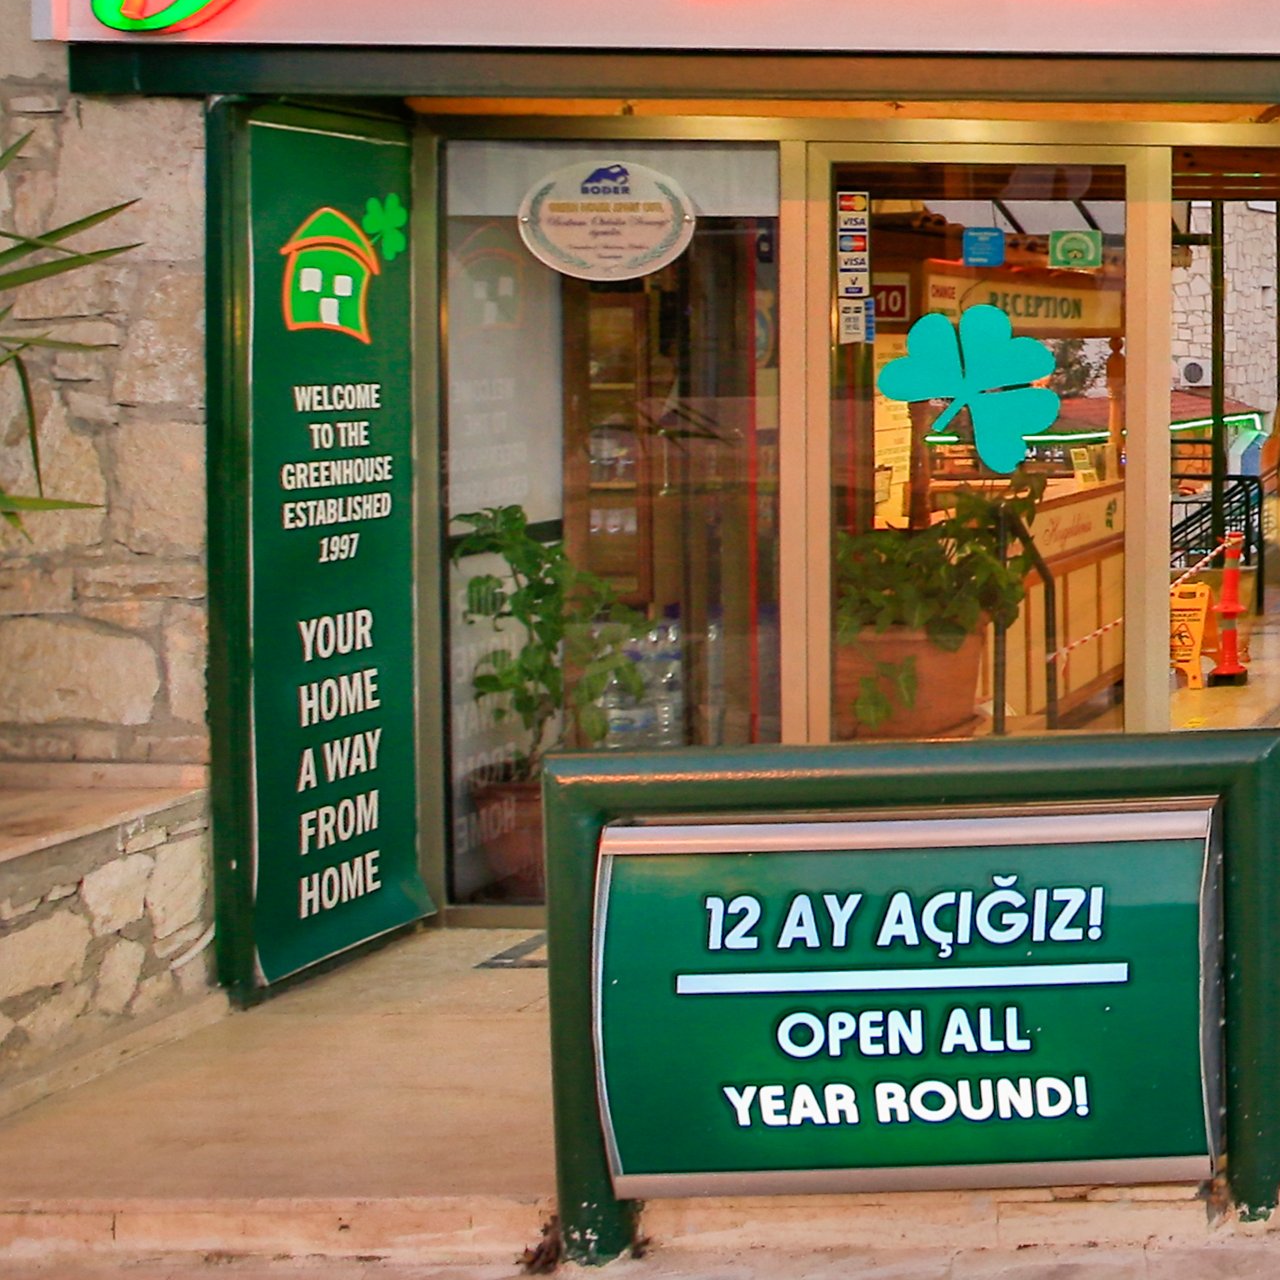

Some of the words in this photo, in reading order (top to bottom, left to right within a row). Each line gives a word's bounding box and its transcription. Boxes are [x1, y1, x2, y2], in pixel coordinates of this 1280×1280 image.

[580, 186, 630, 195] BODER
[843, 217, 866, 226] VISA
[843, 257, 866, 266] VISA
[876, 291, 901, 313] 10
[988, 290, 1082, 319] RECEPTION
[294, 383, 381, 412] WELCOME
[309, 423, 333, 449] TO
[336, 421, 370, 448] THE
[281, 455, 393, 490] GREENHOUSE
[283, 492, 392, 529] ESTABLISHED
[318, 532, 360, 563] 1997
[298, 609, 373, 662] YOUR
[299, 668, 381, 727] HOME
[297, 748, 318, 792] A
[322, 728, 382, 783] WAY
[300, 789, 379, 856] FROM
[300, 850, 382, 920] HOME
[706, 896, 761, 950] 12
[777, 893, 863, 949] AY
[876, 875, 1105, 958] AÇIĞIZ!
[776, 1008, 924, 1058] OPEN
[941, 1006, 1031, 1053] ALL
[722, 1082, 860, 1126] YEAR
[875, 1076, 1090, 1122] ROUND!
